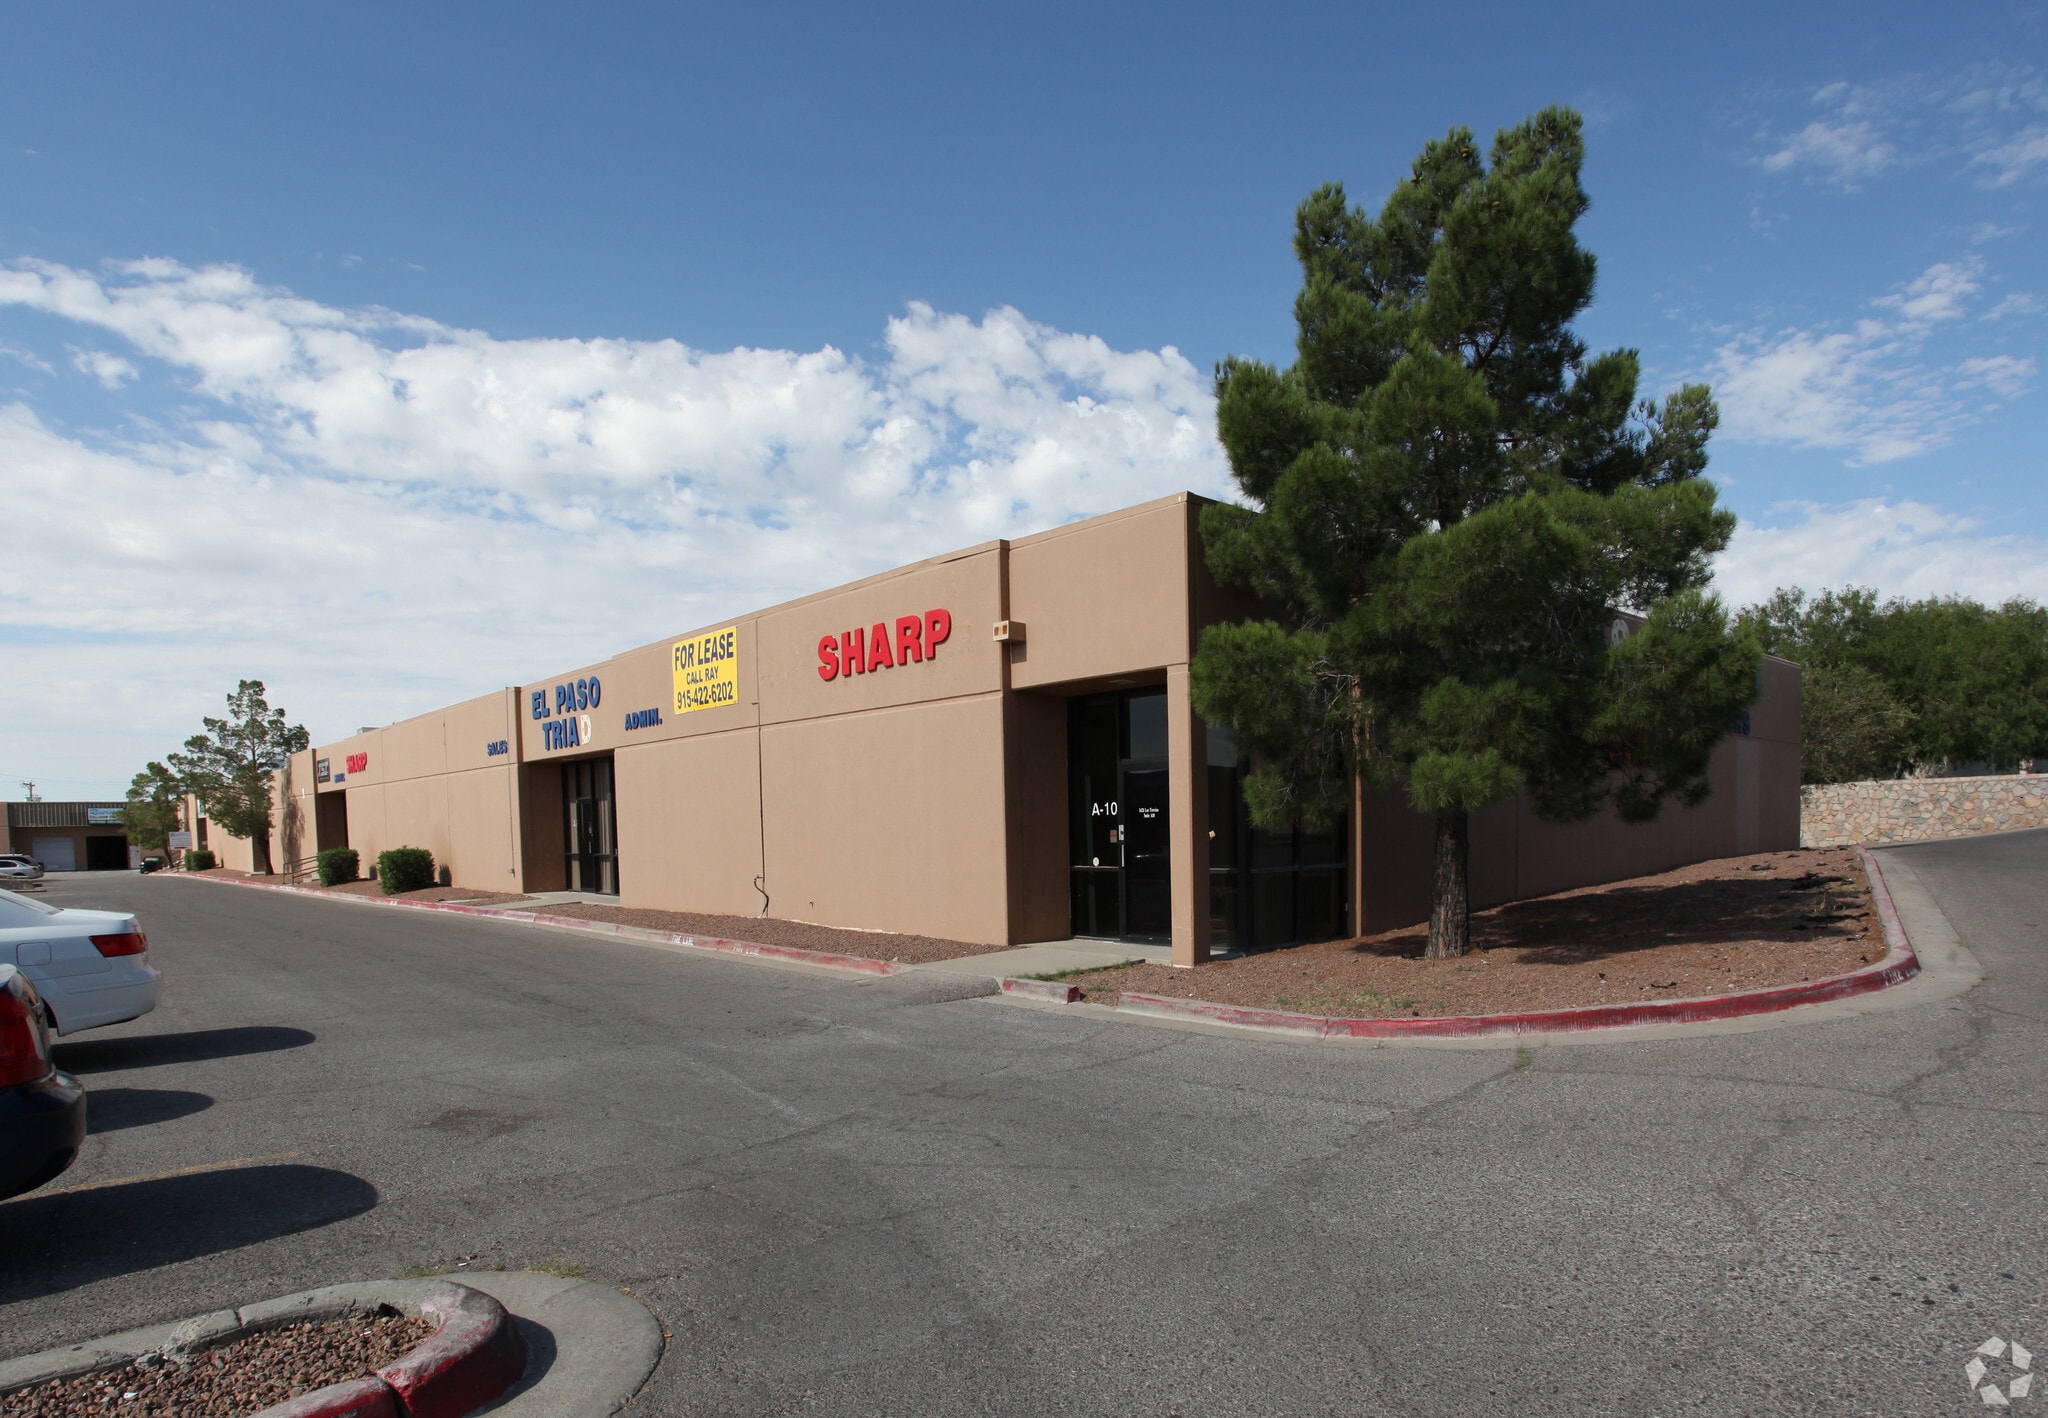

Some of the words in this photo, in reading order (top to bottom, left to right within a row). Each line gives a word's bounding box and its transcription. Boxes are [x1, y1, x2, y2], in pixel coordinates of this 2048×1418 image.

[675, 643, 695, 671] FOR
[698, 632, 734, 665] LEASE
[817, 608, 952, 682] SHARP
[686, 670, 703, 685] CALL
[705, 666, 719, 681] RAY
[531, 689, 550, 720] EL
[555, 676, 601, 714] PASO
[677, 681, 734, 709] 915-422-6202
[542, 714, 592, 750] TRIAD
[625, 708, 663, 731] ADMIN.
[487, 740, 508, 756] SALES
[1092, 801, 1118, 816] A-10
